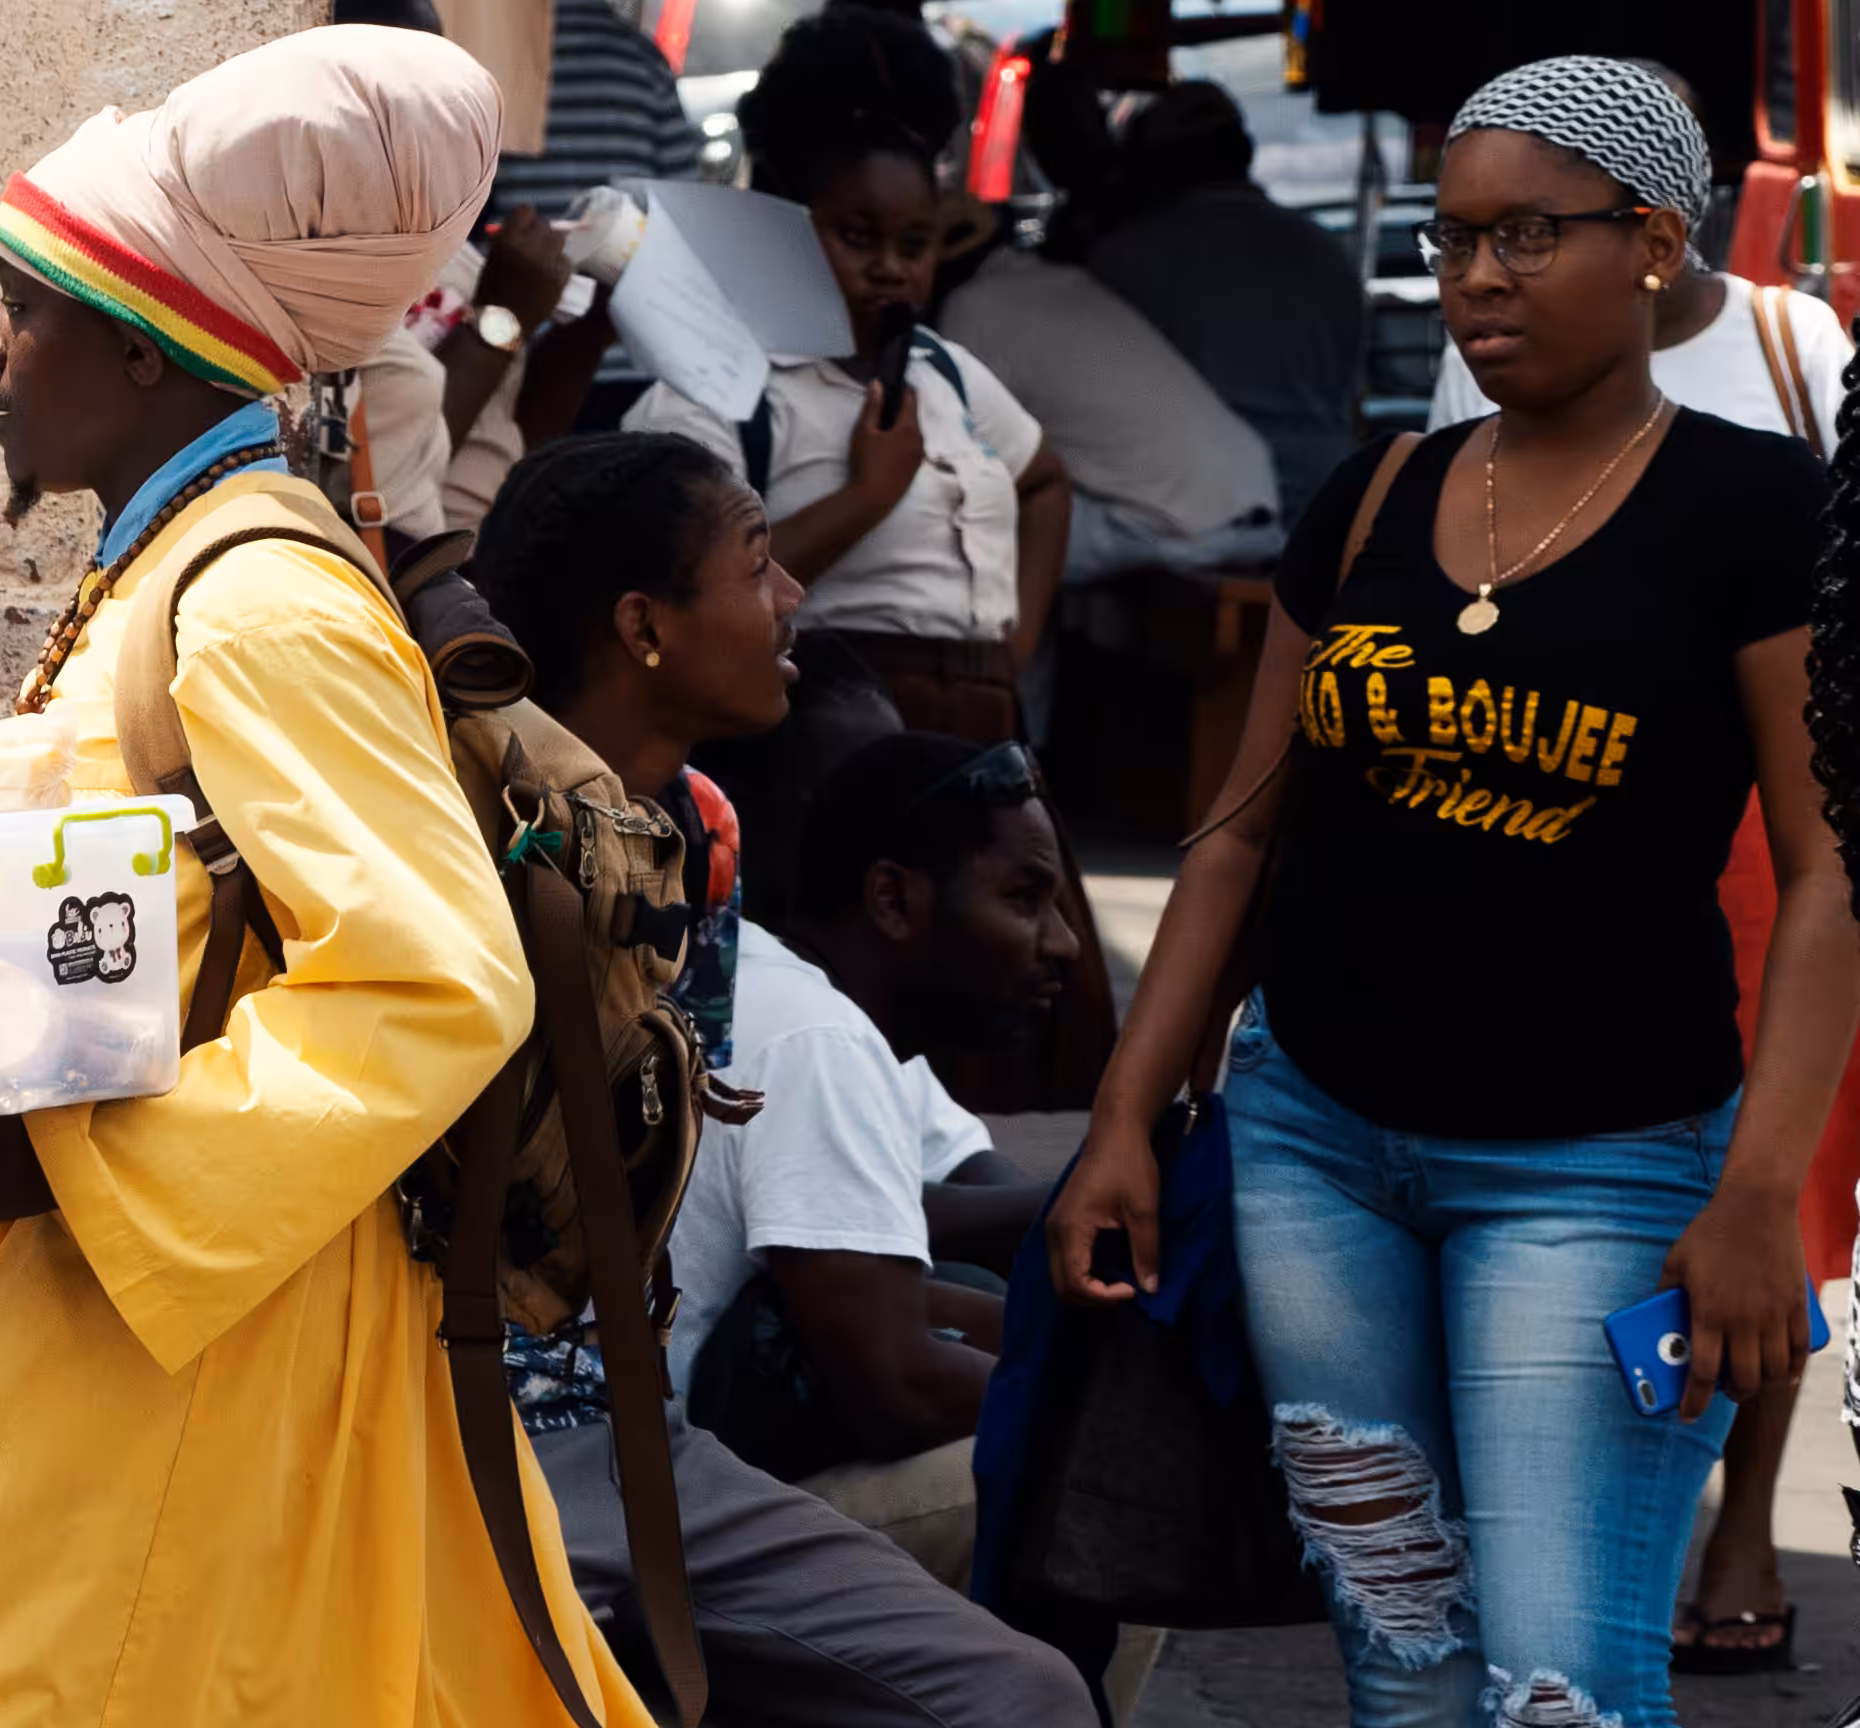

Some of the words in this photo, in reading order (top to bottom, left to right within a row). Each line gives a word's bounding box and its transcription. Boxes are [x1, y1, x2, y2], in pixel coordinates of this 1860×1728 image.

[1303, 624, 1416, 670] The
[1367, 671, 1405, 743] &
[1427, 676, 1639, 786] BOUJEE
[1366, 747, 1597, 844] Friend
